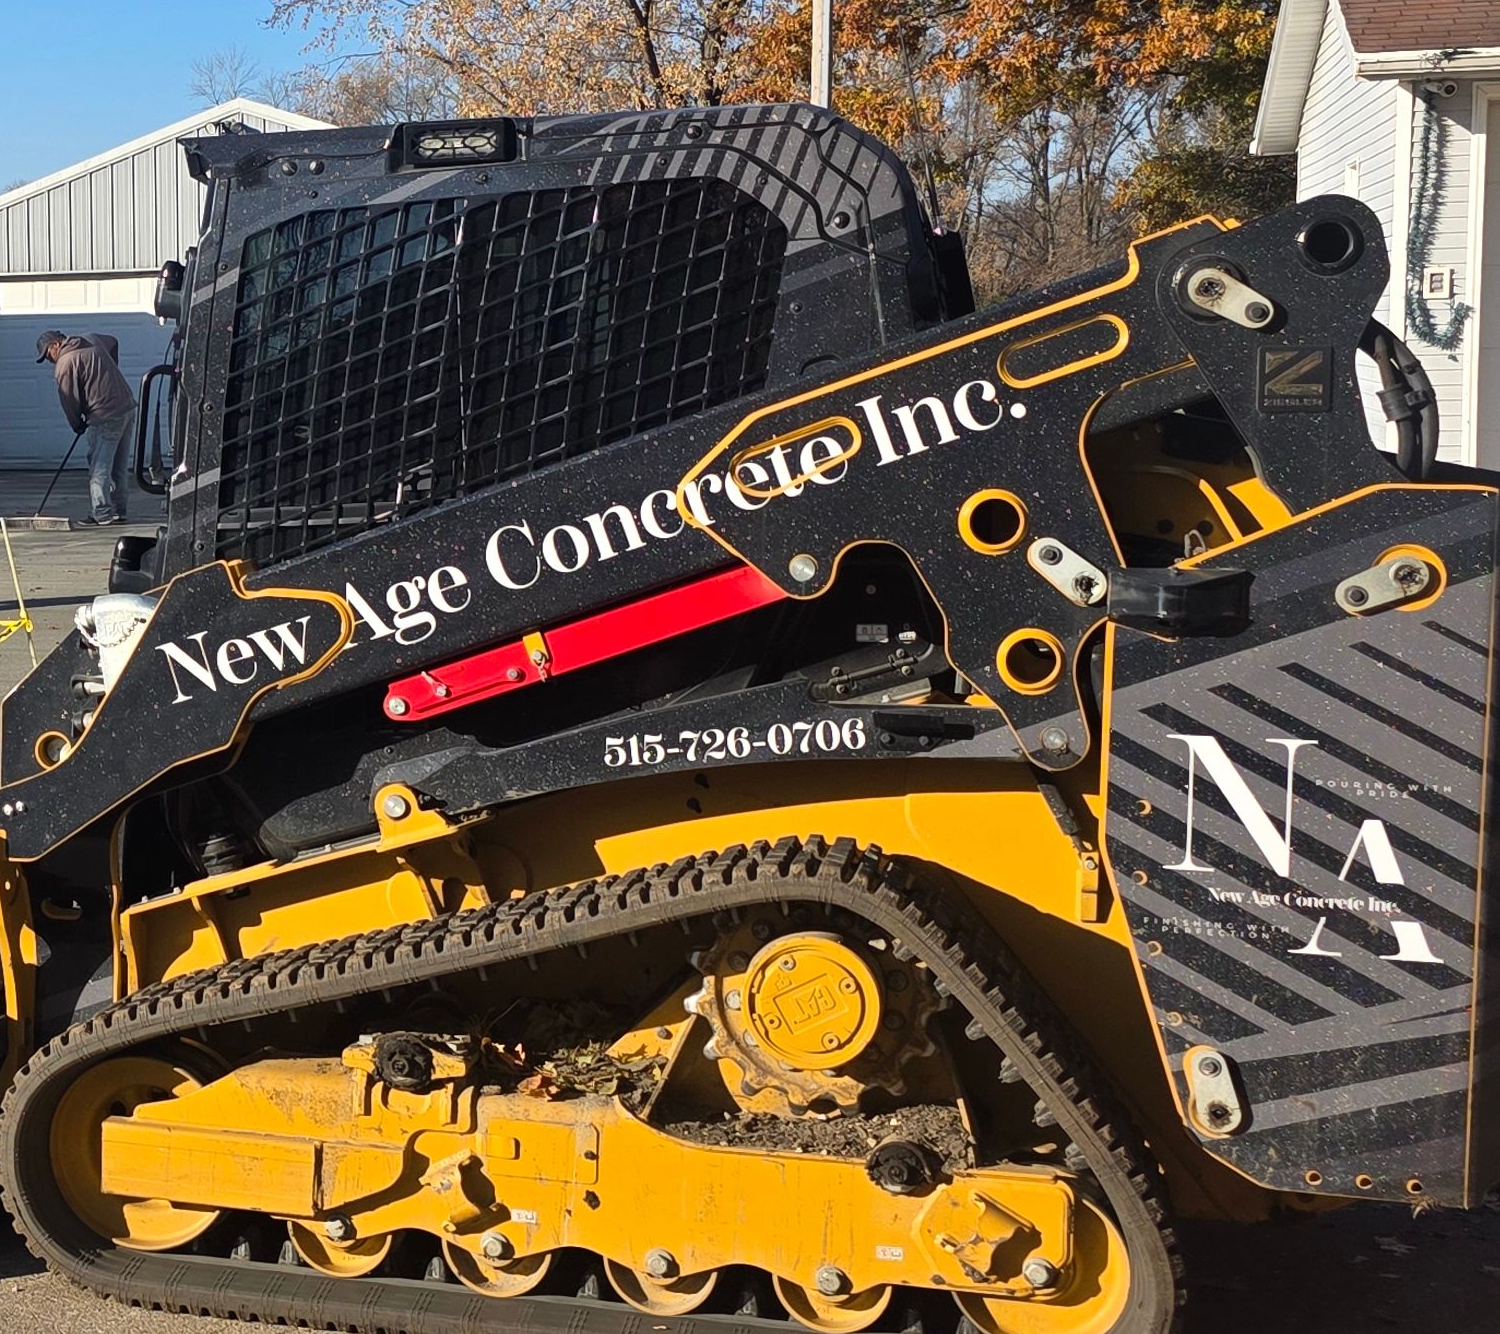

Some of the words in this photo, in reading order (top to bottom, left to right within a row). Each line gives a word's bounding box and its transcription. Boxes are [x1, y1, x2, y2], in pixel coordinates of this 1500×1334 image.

[155, 616, 311, 705] New
[337, 565, 472, 650] Age
[485, 435, 849, 590] Concrete
[855, 379, 1027, 468] Inc.
[603, 717, 866, 767] 515-726-0706
[1315, 779, 1396, 790] POURING
[1408, 784, 1452, 792] WITH
[1356, 789, 1411, 799] PRIDE
[1162, 734, 1319, 878] N
[1208, 887, 1244, 904] New
[1247, 890, 1280, 906] Age
[1283, 892, 1364, 910] Concrete
[1368, 897, 1401, 913] Inc.
[1287, 820, 1444, 964] A
[1143, 917, 1234, 929] FINISHING
[1246, 924, 1289, 933] WITH
[1161, 926, 1270, 939] PERFECTION
